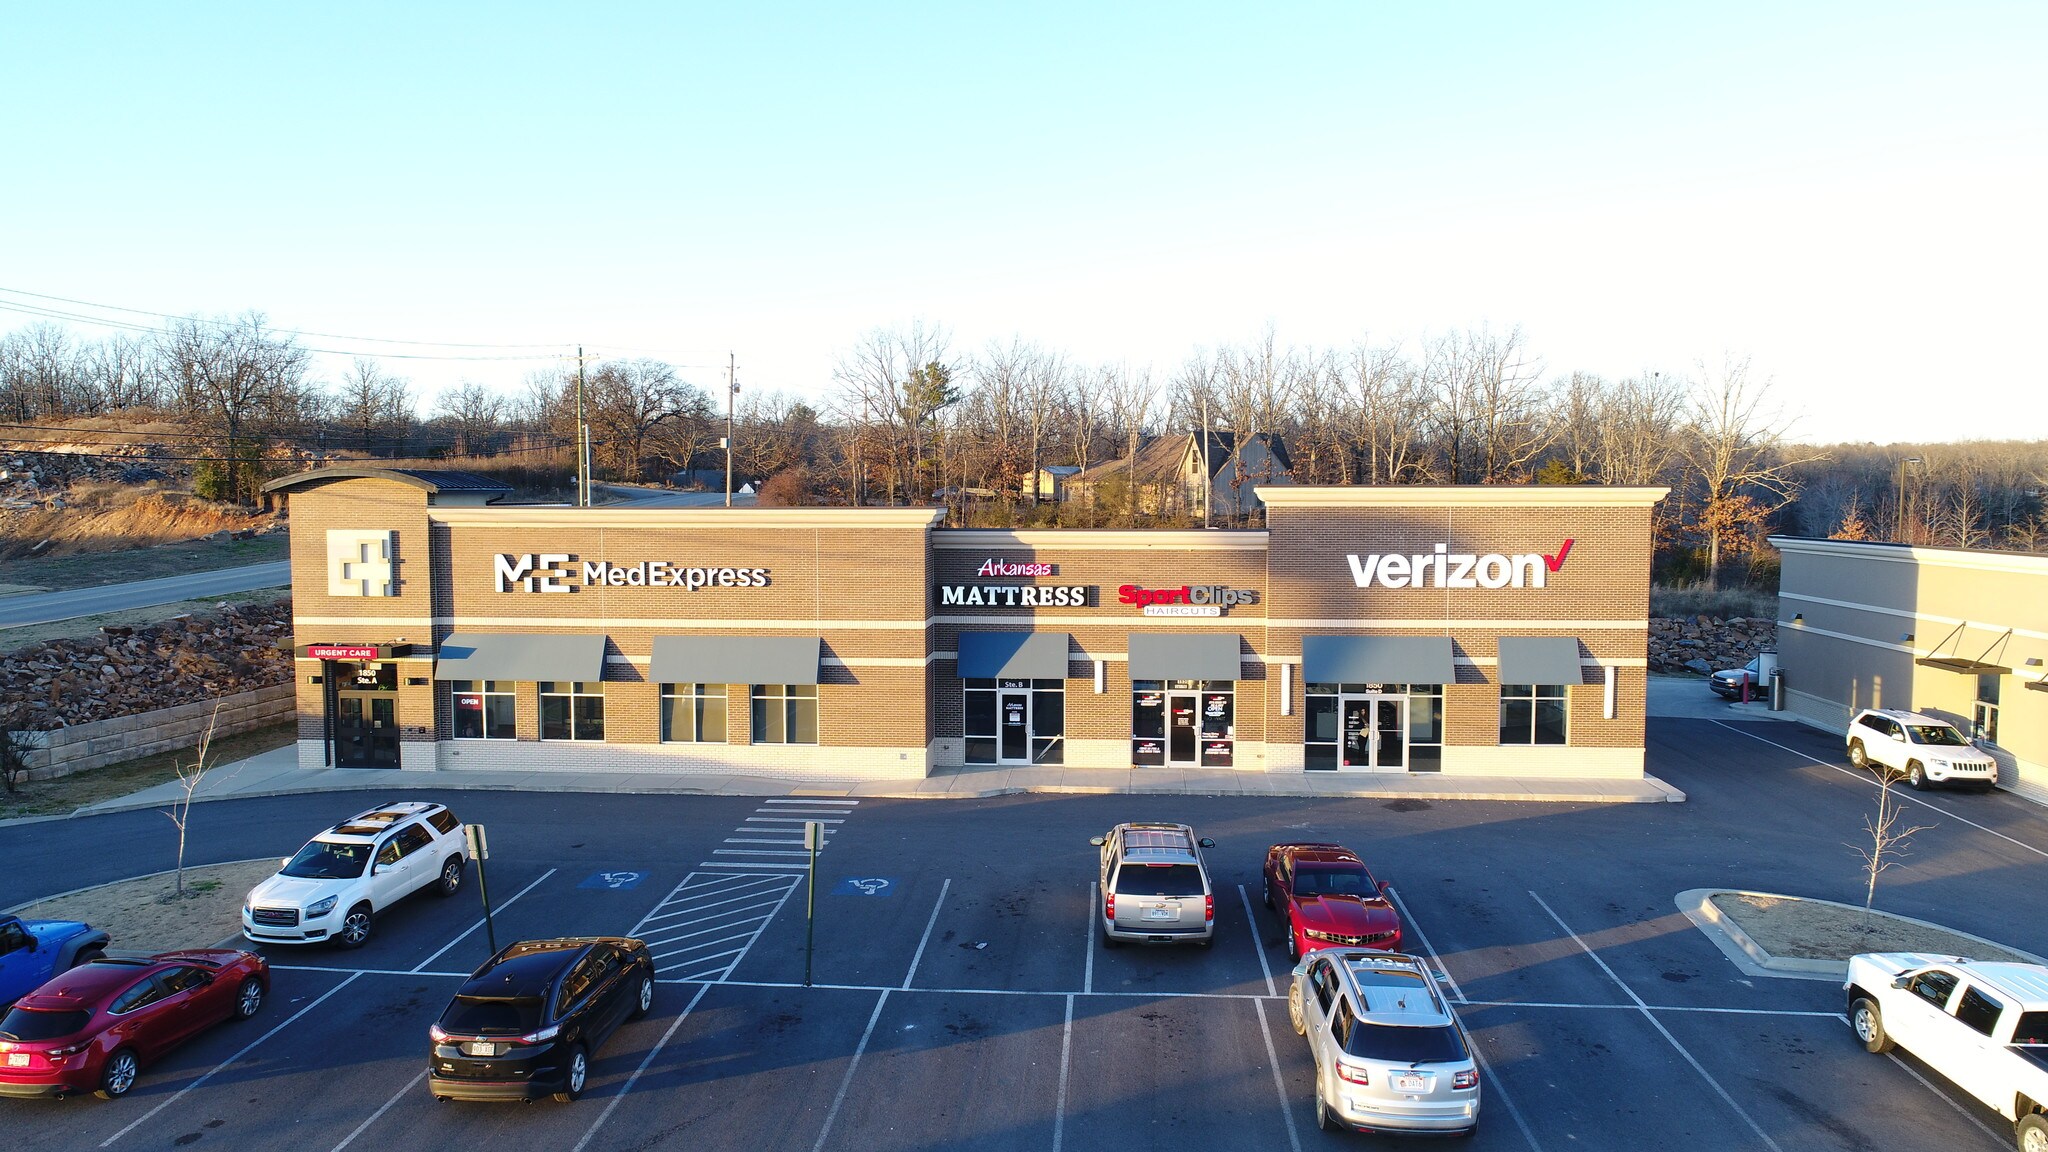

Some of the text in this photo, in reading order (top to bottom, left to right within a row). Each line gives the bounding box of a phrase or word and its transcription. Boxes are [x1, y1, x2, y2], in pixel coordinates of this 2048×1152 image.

[977, 558, 1051, 577] Arkansas
[1346, 543, 1546, 589] verizon
[582, 561, 767, 591] MedExpress
[941, 586, 1085, 607] MATTRESS
[1146, 607, 1218, 615] HAIRCUTS
[314, 649, 347, 657] URGENT
[358, 669, 376, 677] 1850
